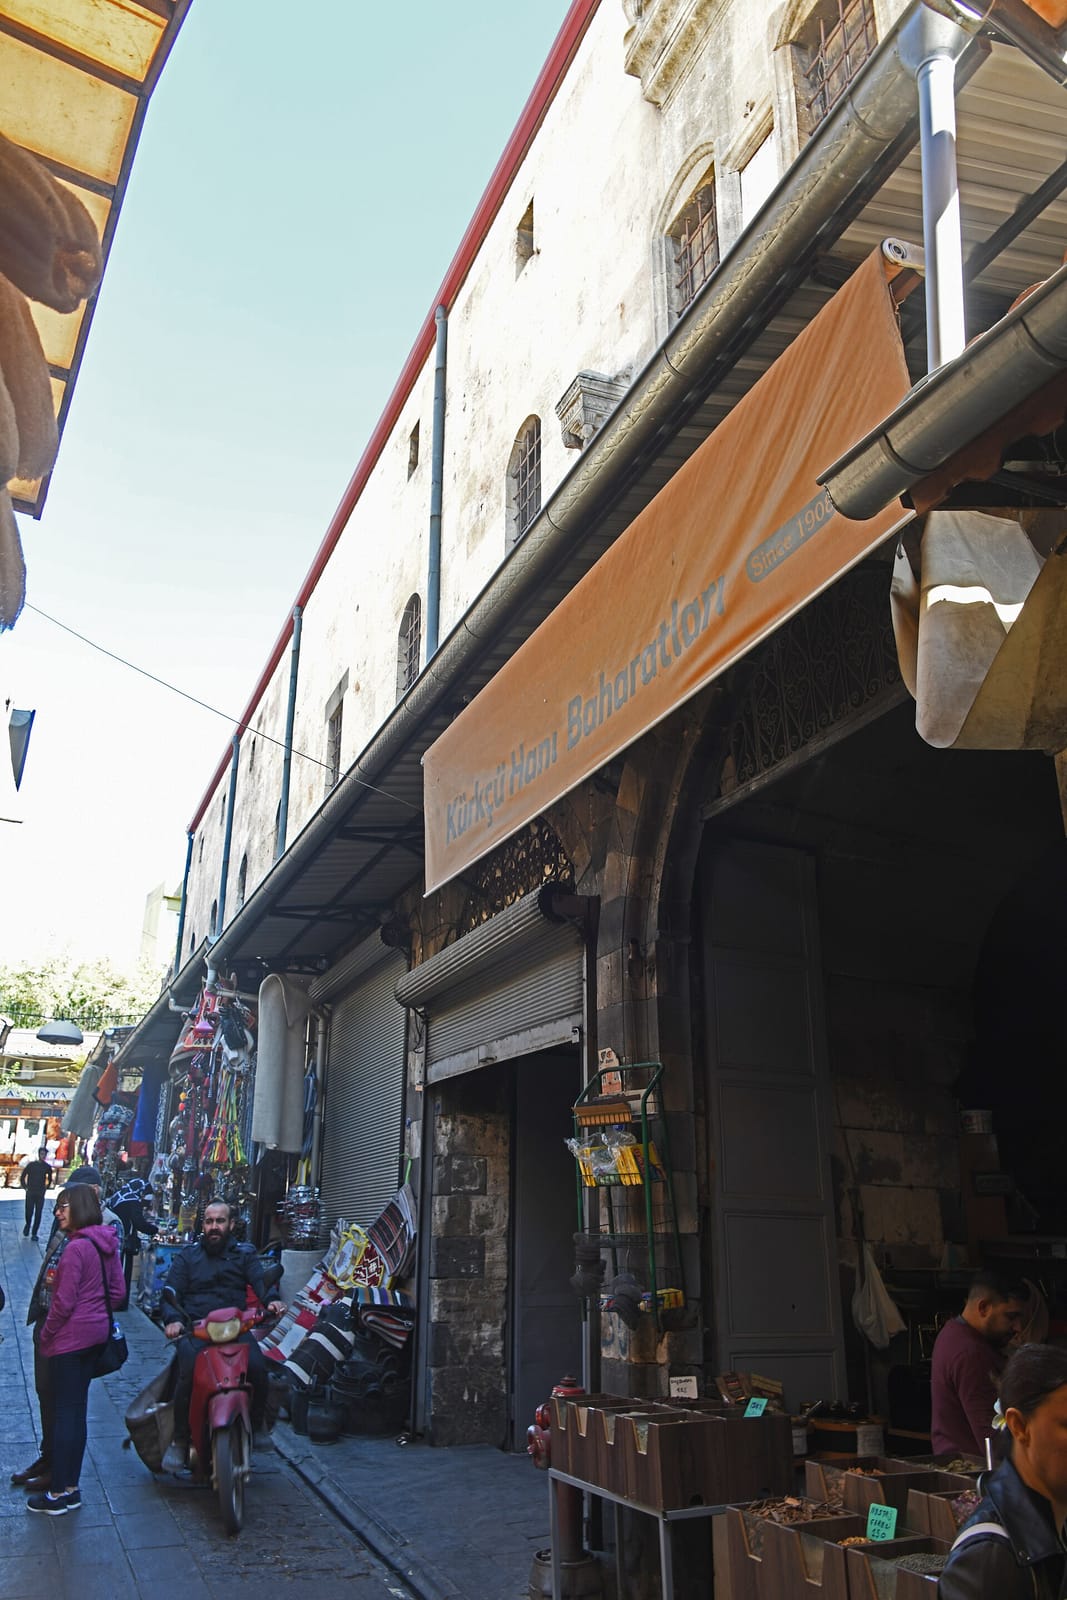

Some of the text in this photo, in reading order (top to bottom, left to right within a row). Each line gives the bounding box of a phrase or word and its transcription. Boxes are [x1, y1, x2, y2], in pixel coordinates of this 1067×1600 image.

[751, 535, 793, 577] Since
[445, 574, 726, 846] Kürkçü Hanı Baharatları
